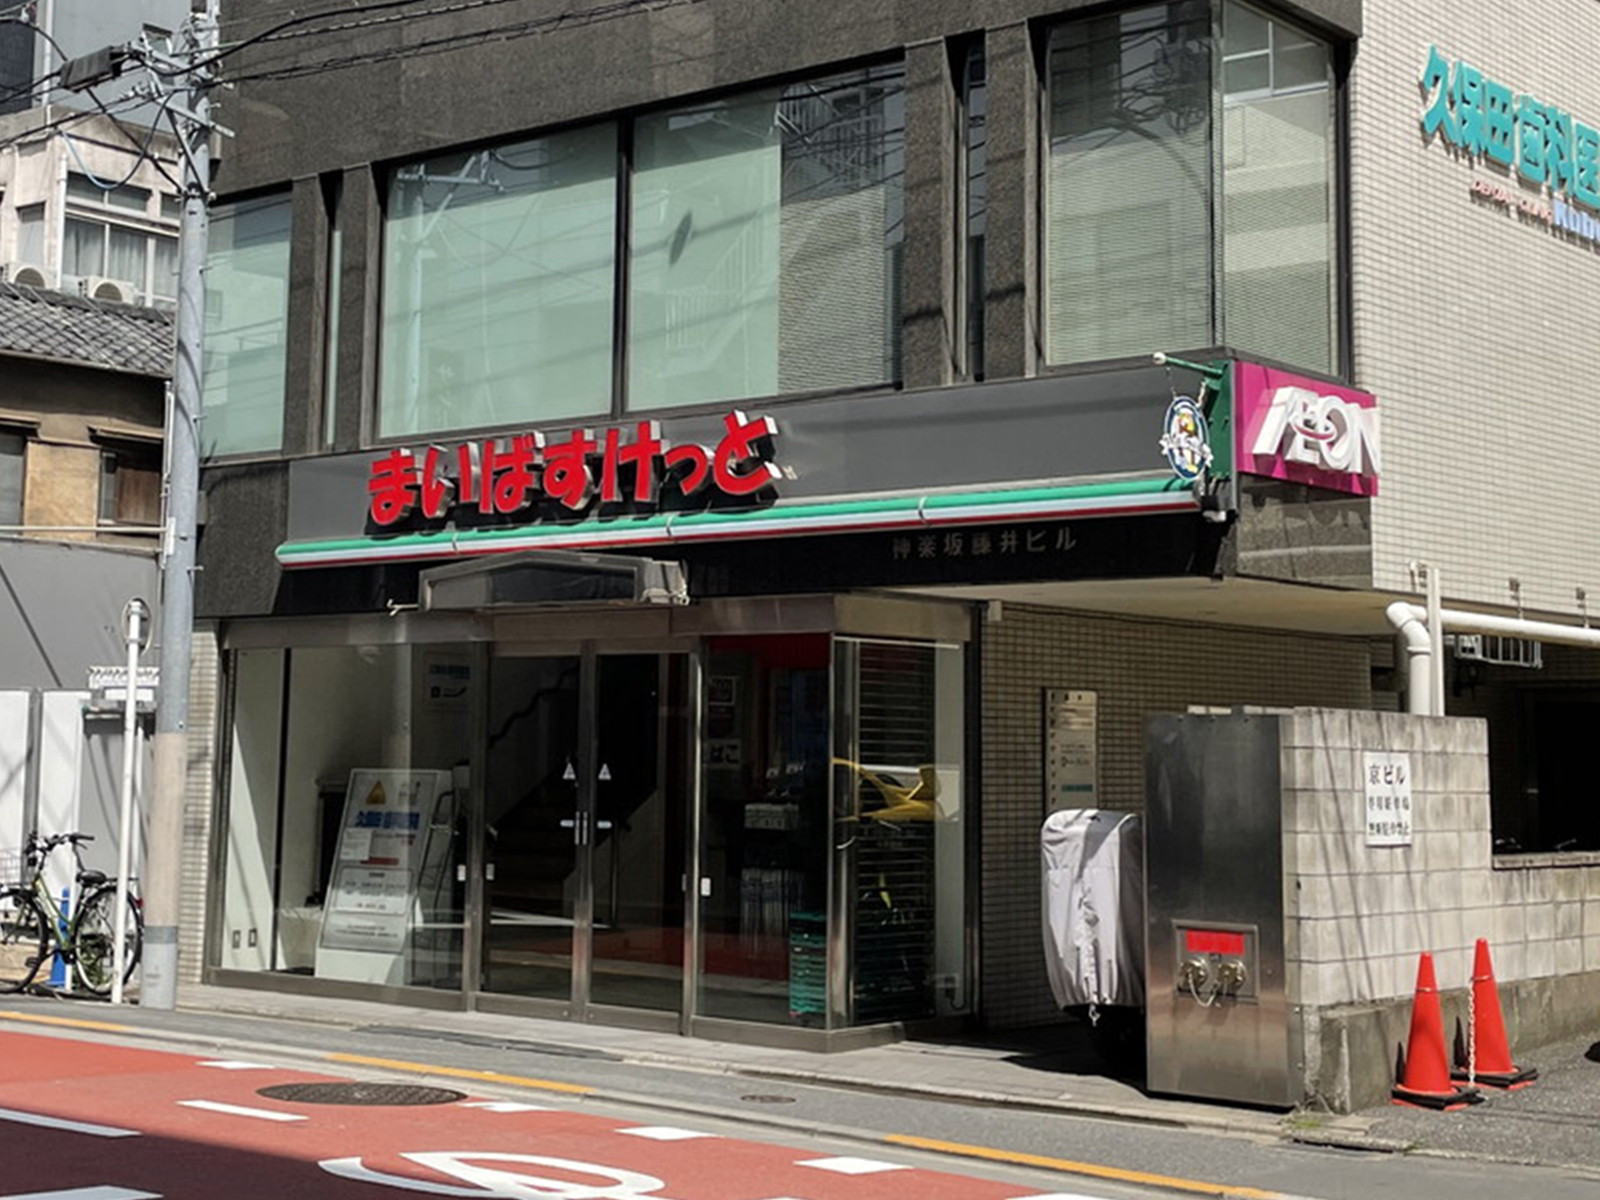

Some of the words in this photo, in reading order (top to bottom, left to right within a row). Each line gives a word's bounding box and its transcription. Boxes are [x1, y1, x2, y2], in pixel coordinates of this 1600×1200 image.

[367, 409, 778, 526] まいばすけっと
[893, 526, 1077, 559] 神楽坂藤井ビル
